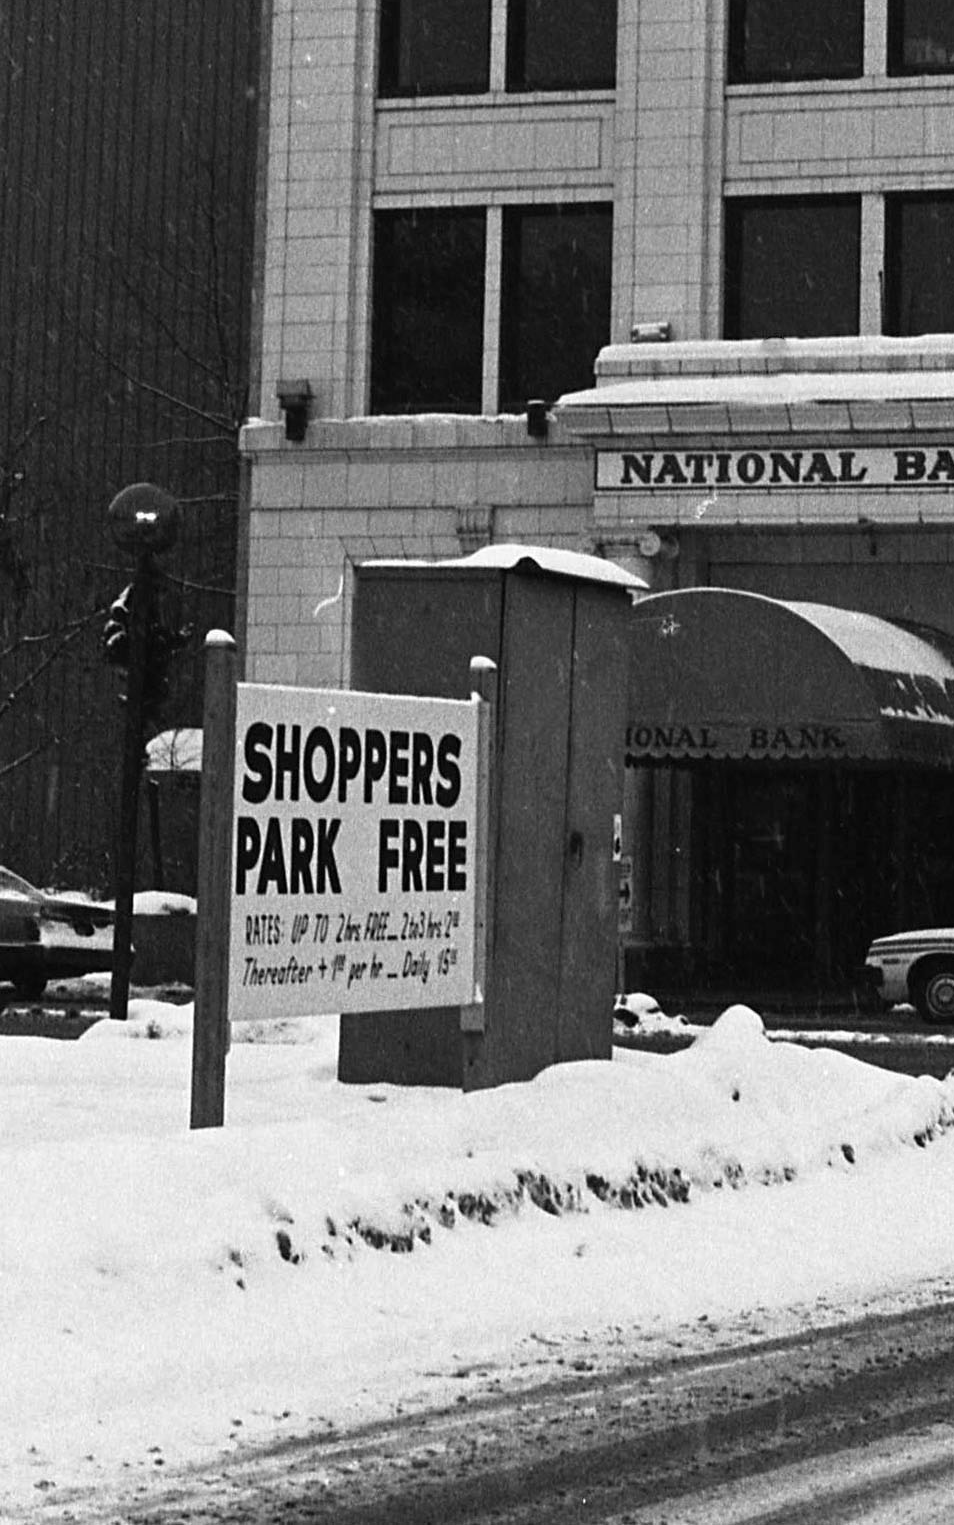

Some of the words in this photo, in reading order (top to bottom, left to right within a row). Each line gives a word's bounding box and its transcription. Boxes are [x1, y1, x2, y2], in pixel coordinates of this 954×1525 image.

[620, 451, 868, 484] NATIONAL
[625, 727, 717, 749] IONAL
[749, 727, 847, 750] BANK
[242, 721, 462, 809] SHOPPERS
[235, 816, 342, 896] PARK
[378, 818, 468, 894] FREE
[245, 913, 285, 946] RATES:
[291, 913, 309, 945] UP
[313, 913, 329, 944] TO
[363, 911, 390, 942] FREE
[242, 955, 313, 987] Thereafter
[346, 961, 366, 990] per
[370, 951, 383, 979] hr
[402, 950, 431, 985] Daily
